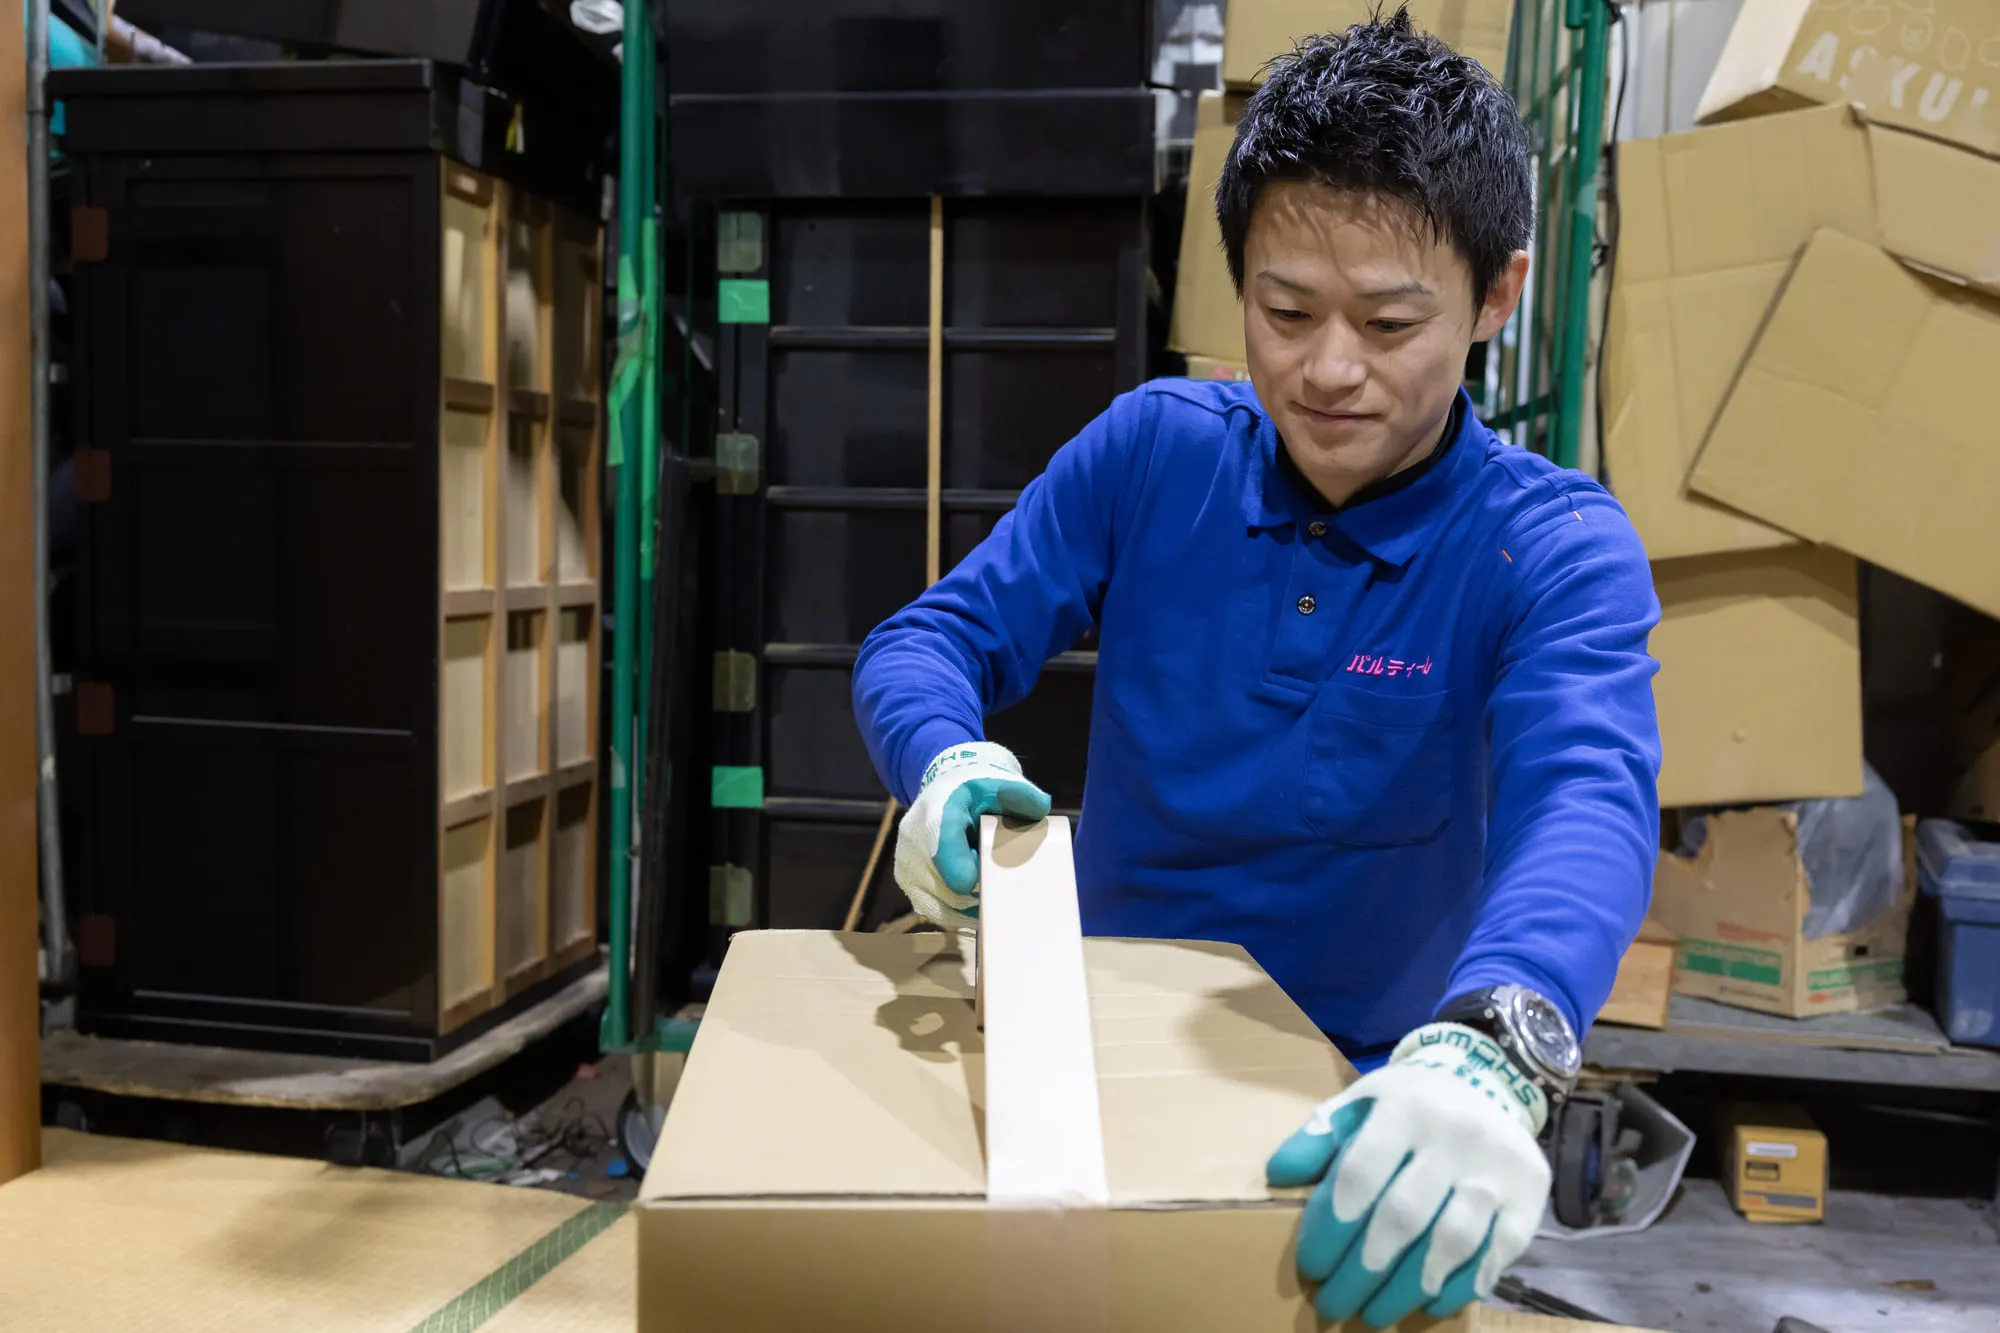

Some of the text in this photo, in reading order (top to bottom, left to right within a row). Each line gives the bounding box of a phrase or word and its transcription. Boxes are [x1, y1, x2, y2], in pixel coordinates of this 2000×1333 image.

[1346, 654, 1433, 678] パルティール
